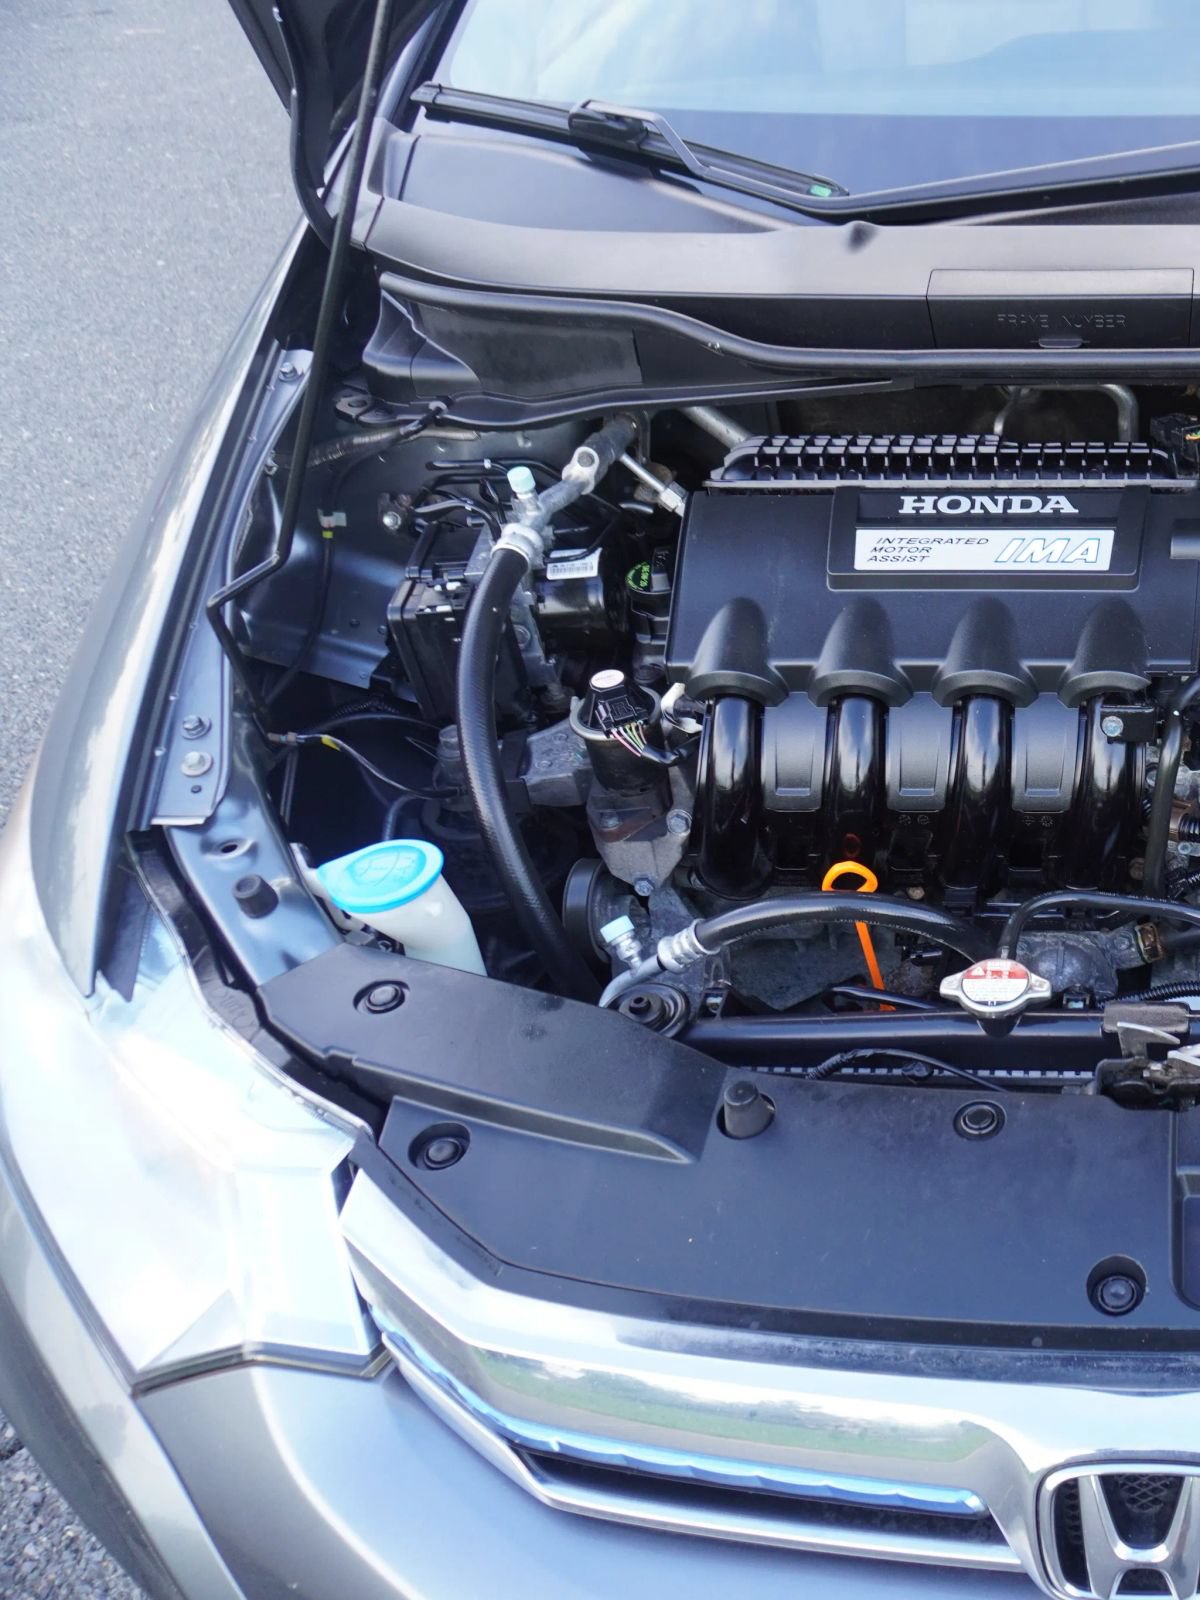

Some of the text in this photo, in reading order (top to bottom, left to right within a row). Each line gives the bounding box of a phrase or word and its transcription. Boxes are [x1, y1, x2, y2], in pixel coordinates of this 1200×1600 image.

[898, 495, 1079, 514] HONDA
[876, 537, 990, 545] INTEGRATED
[994, 537, 1101, 563] IMA
